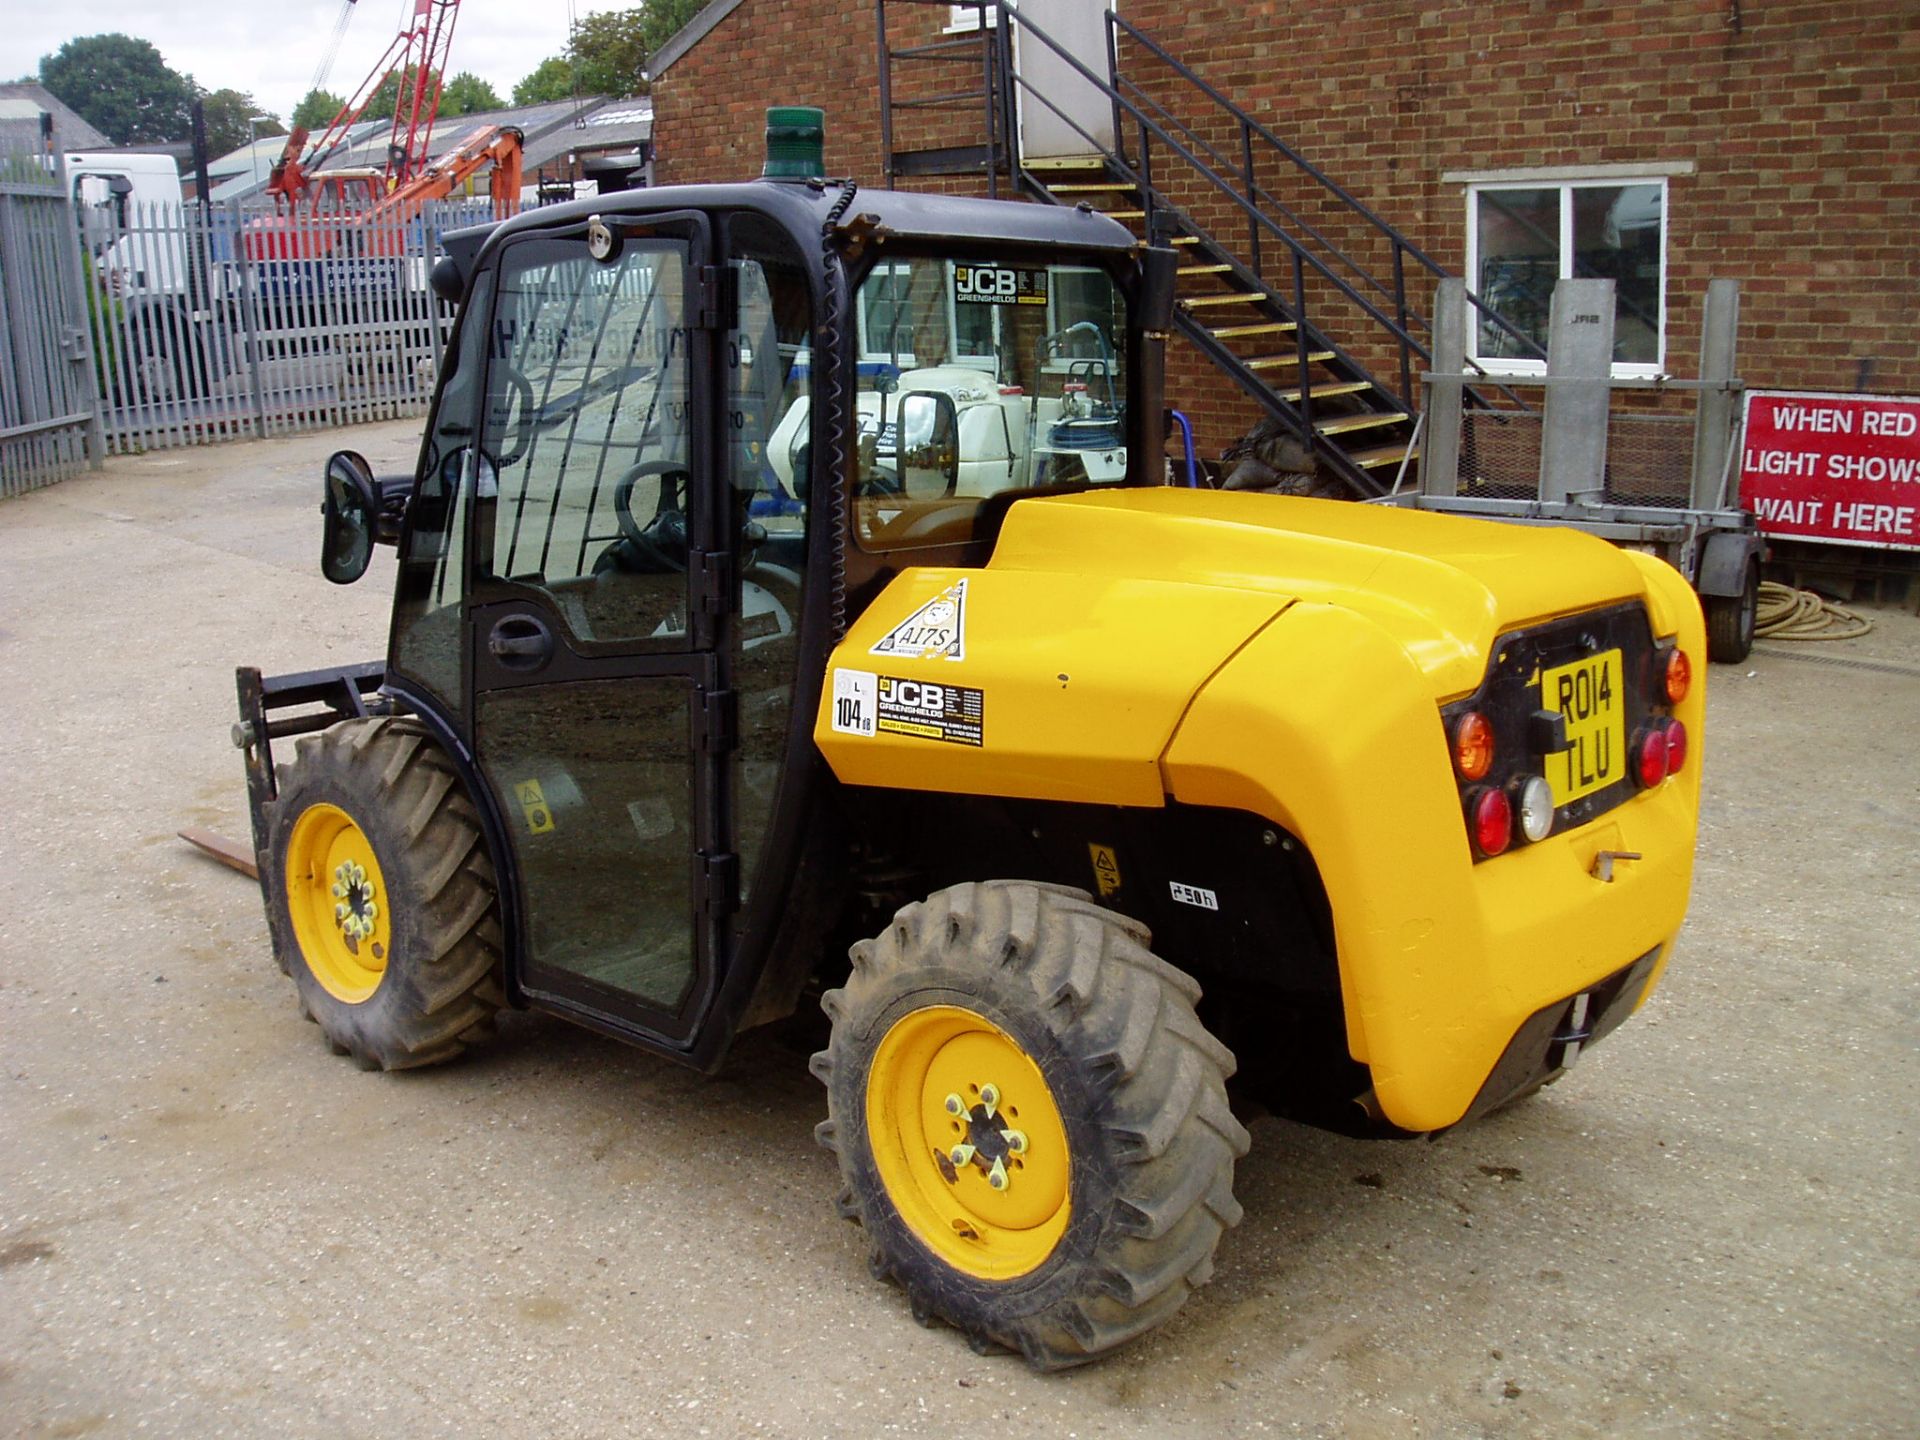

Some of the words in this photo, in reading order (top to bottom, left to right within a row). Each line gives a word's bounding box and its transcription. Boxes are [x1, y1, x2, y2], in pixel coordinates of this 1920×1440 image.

[957, 268, 1016, 295] JCB
[957, 294, 1016, 304] GREENSHIELDS
[1773, 407, 1853, 433] WHEN
[1862, 411, 1917, 436] RED
[1745, 449, 1821, 476] LIGHT
[1754, 497, 1823, 525] WAIT
[1833, 502, 1915, 535] HERE
[879, 679, 944, 710] JCB
[1558, 661, 1612, 724] RO14
[837, 697, 861, 729] 104
[862, 716, 871, 731] dB
[879, 702, 944, 718] GREENSHIELDS
[1563, 727, 1609, 791] TLU
[1184, 887, 1202, 905] 50
